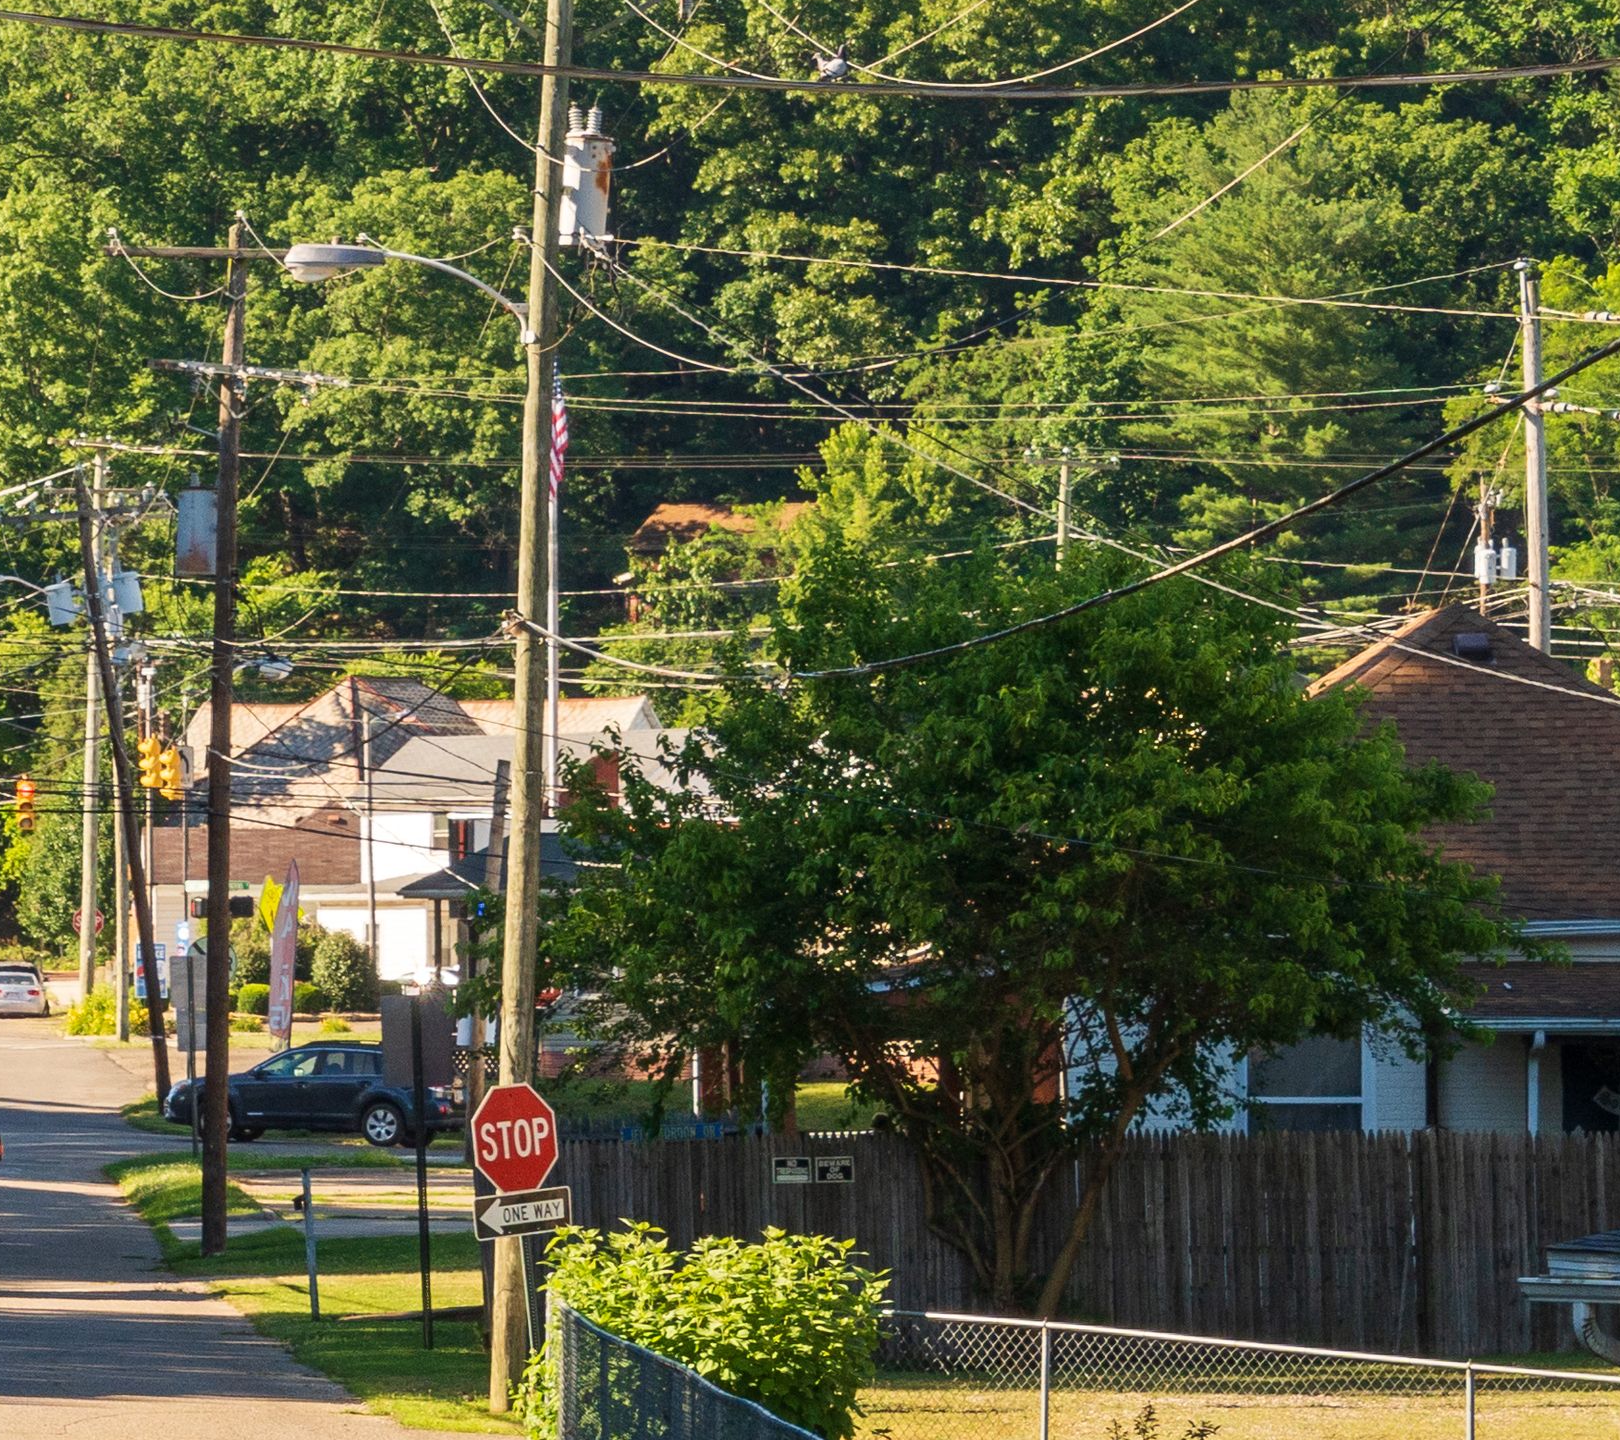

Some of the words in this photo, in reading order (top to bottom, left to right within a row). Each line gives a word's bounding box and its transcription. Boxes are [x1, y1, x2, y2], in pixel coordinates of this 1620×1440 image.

[75, 915, 102, 927] SP
[480, 1117, 549, 1162] STOP
[503, 1205, 528, 1223] ONE
[533, 1201, 561, 1220] WAY
